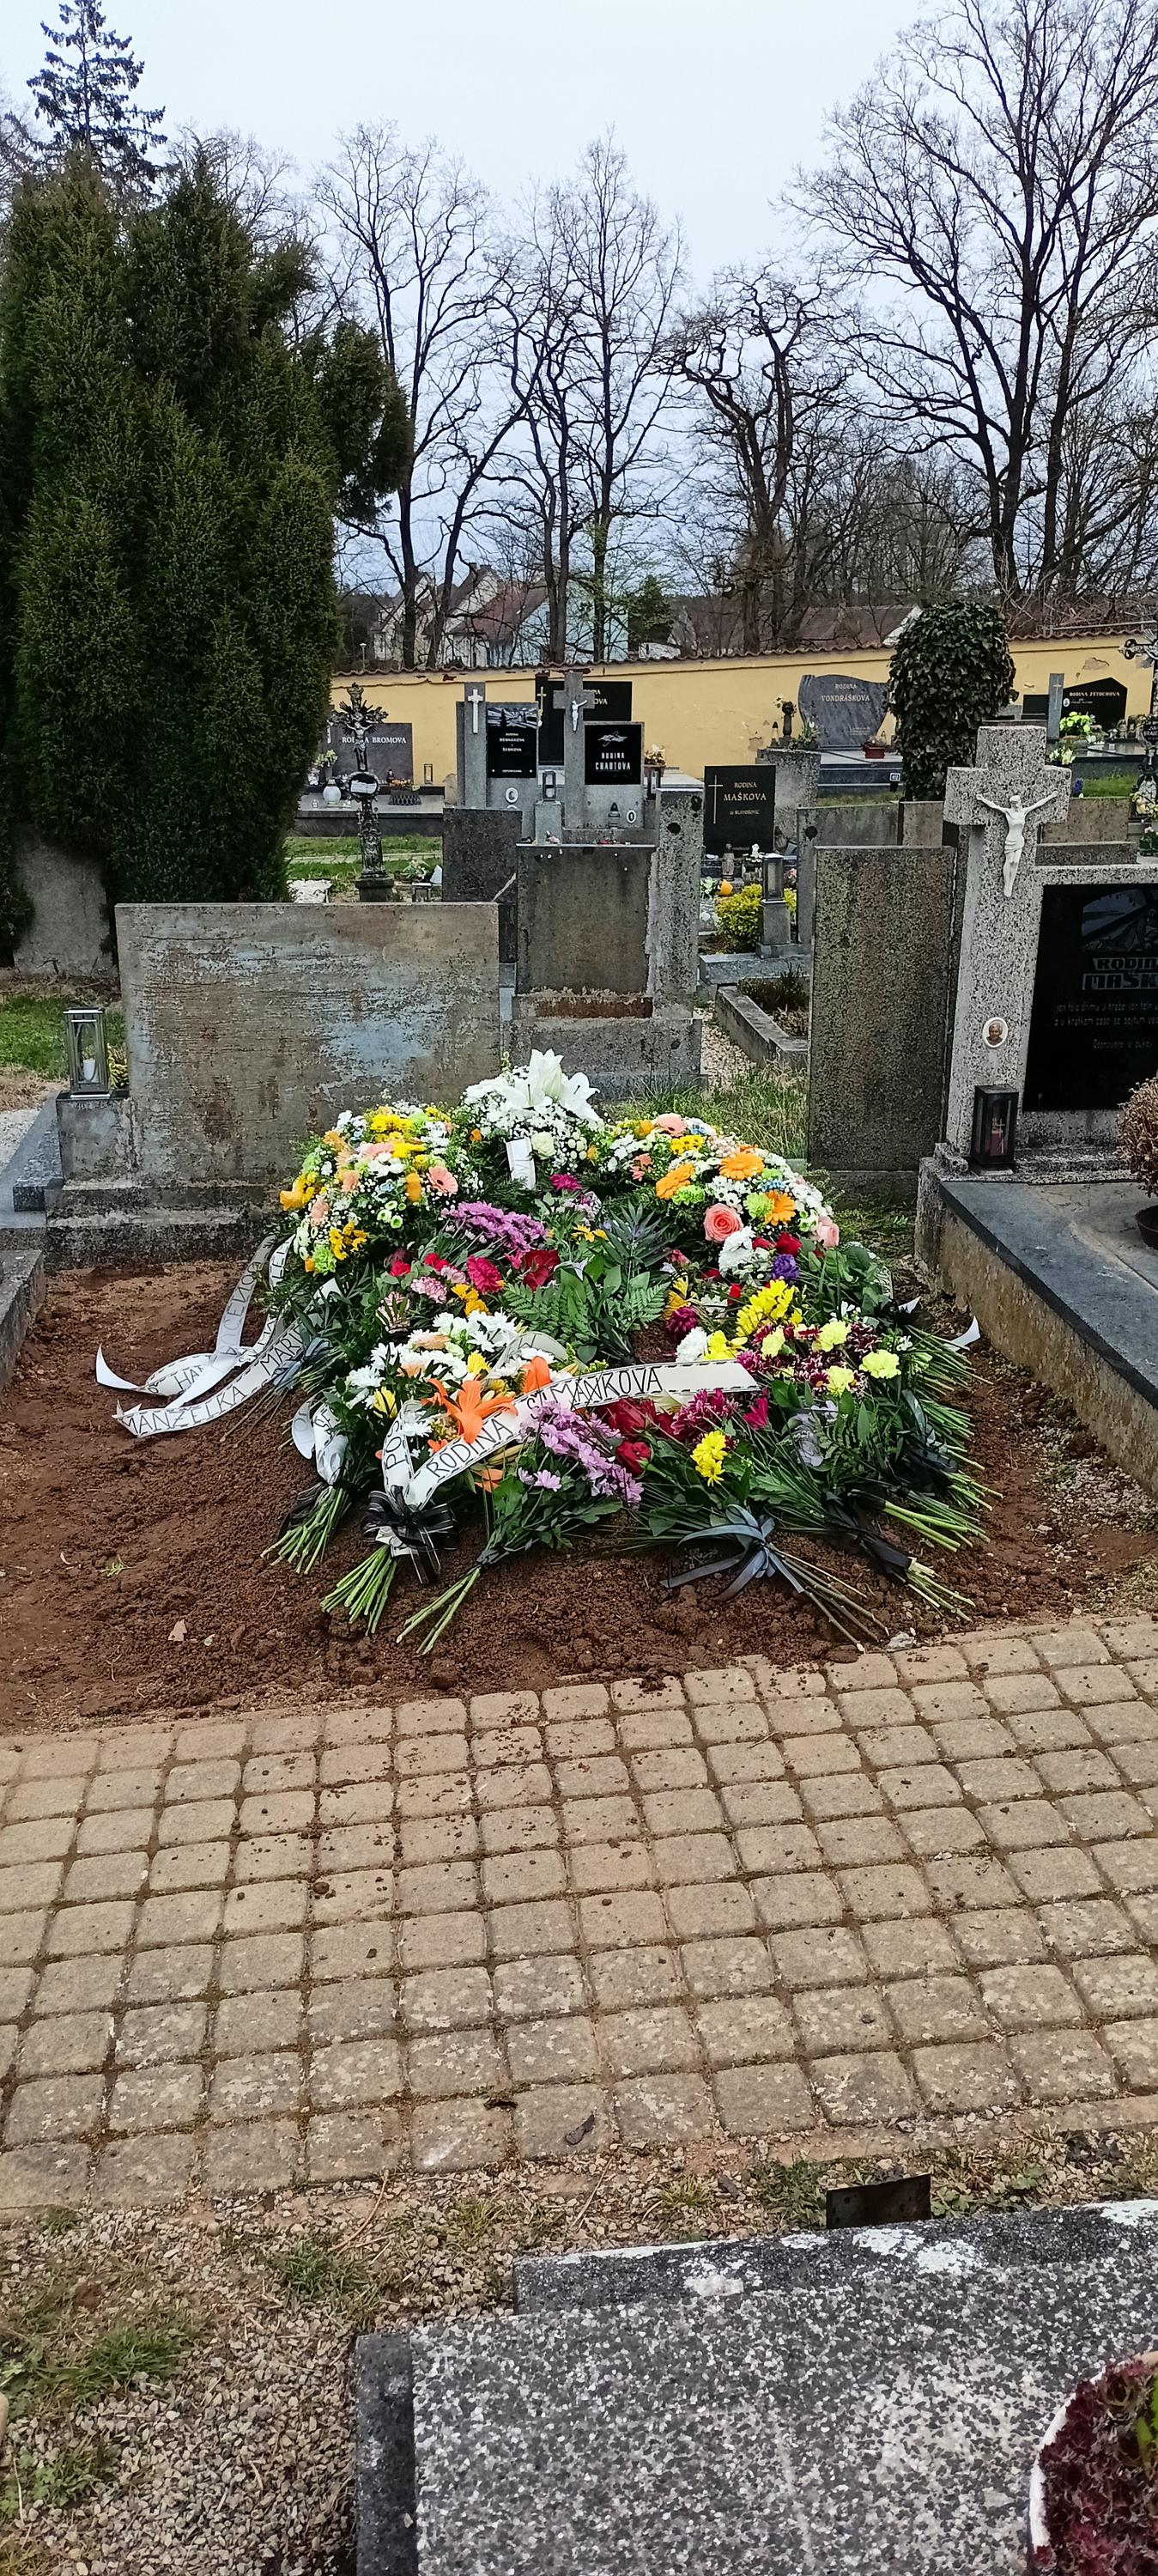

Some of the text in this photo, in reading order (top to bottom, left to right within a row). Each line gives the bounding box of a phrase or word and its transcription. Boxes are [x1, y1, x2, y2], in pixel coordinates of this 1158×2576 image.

[723, 792, 767, 801] MAŠKOVA
[1094, 957, 1158, 970] RODIN
[1082, 970, 1158, 990] MAŠK
[426, 1418, 515, 1478] RODINA
